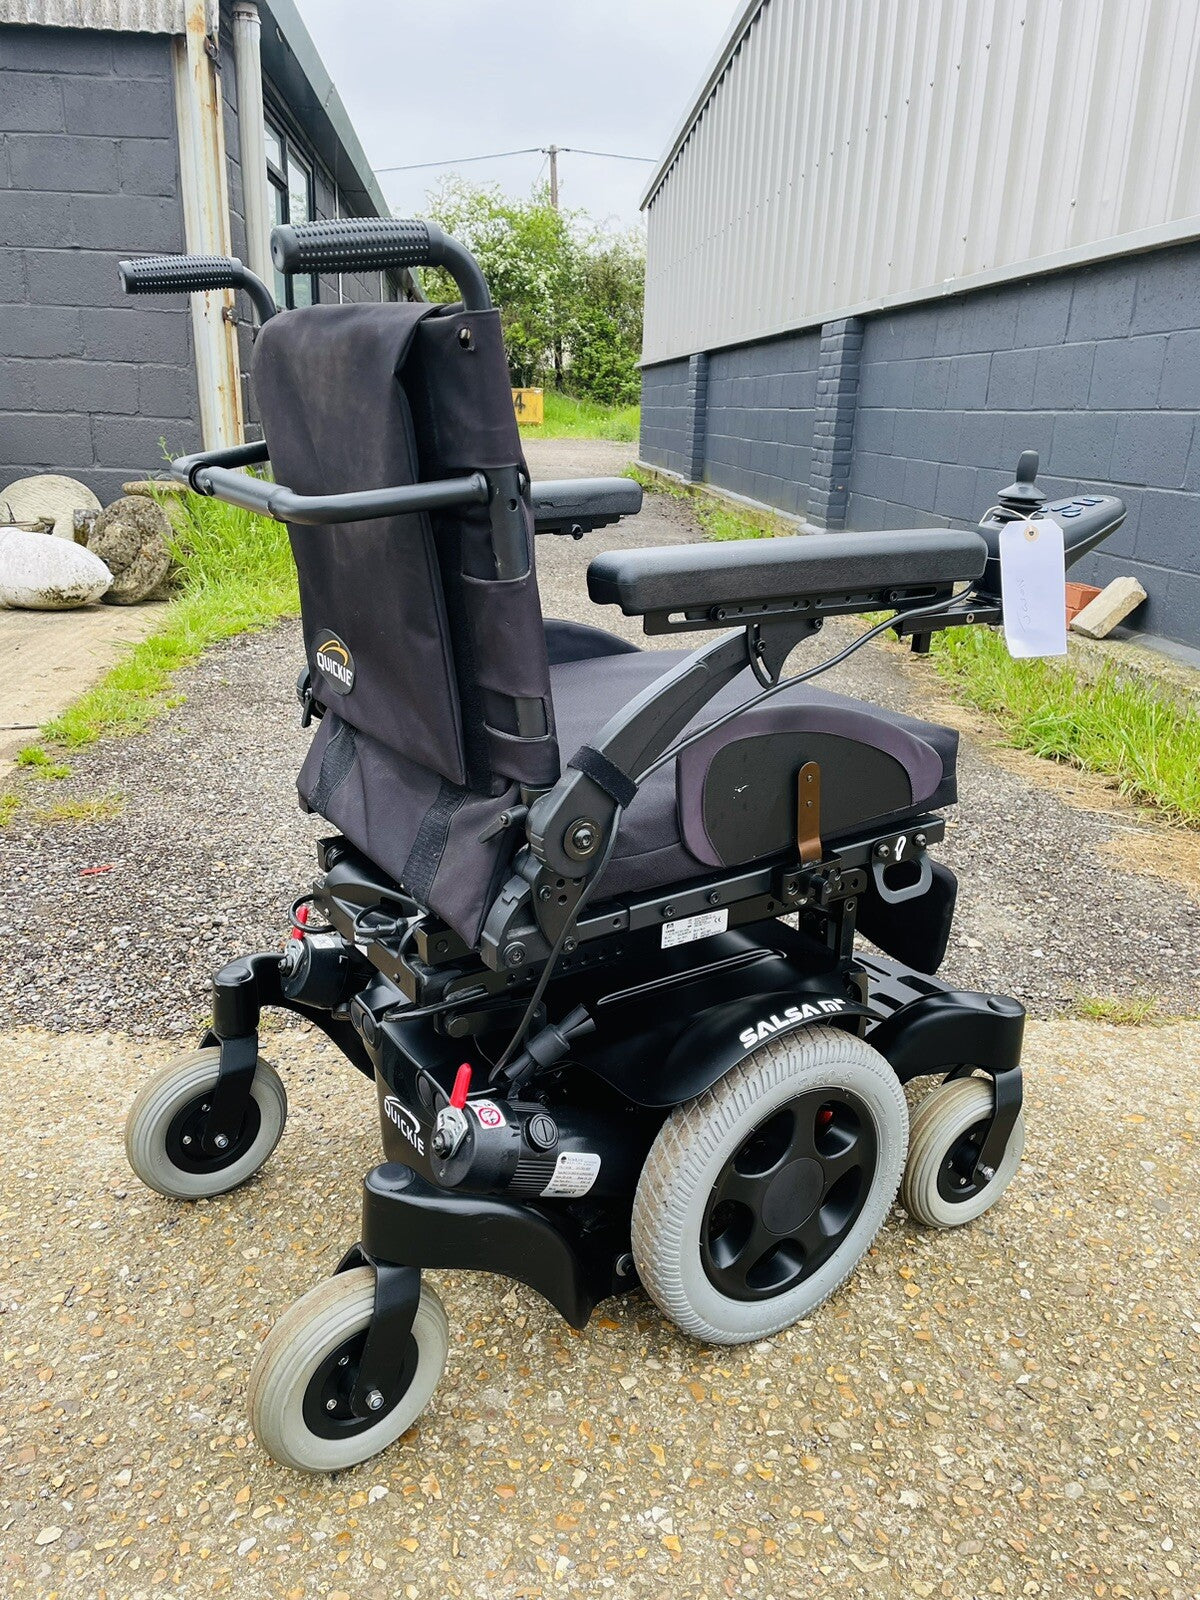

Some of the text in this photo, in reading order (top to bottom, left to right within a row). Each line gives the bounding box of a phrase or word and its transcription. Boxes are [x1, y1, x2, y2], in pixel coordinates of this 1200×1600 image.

[316, 651, 353, 687] QUICKIE
[738, 1003, 822, 1050] SALSA
[383, 1097, 425, 1157] QUICKIE
